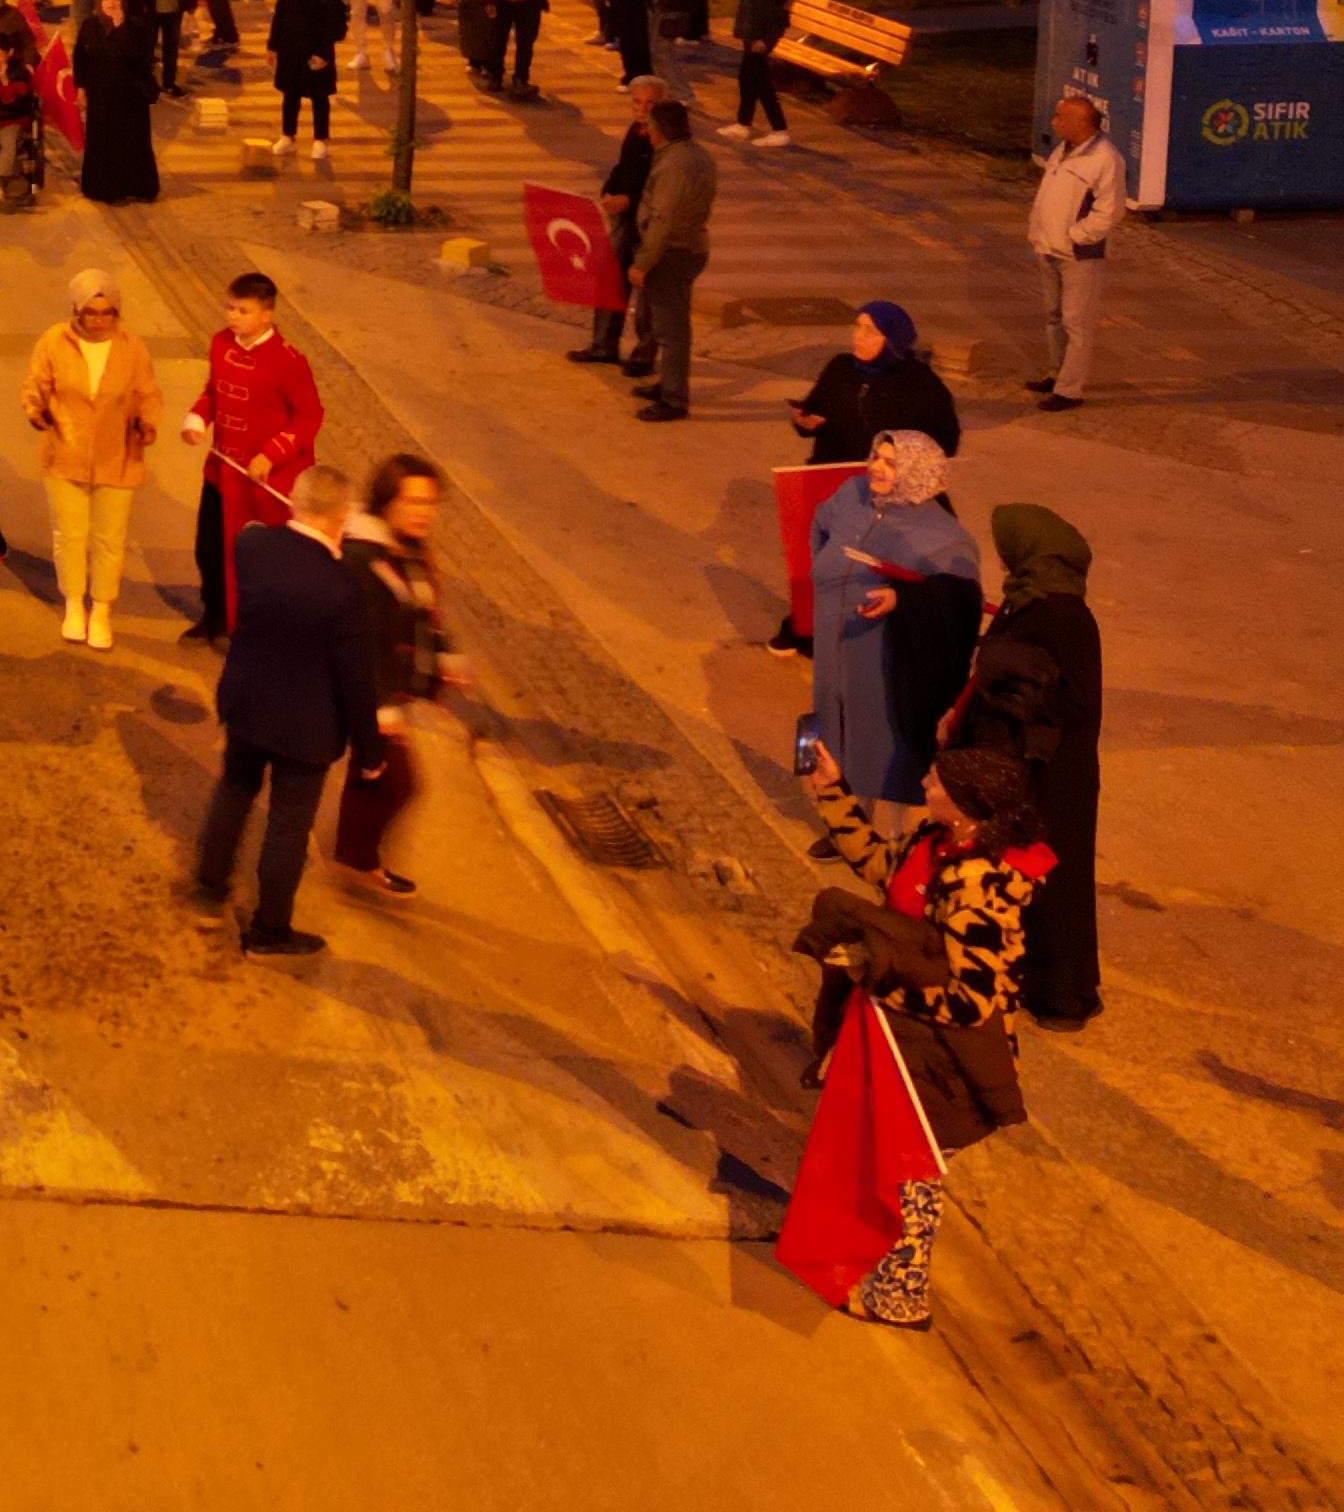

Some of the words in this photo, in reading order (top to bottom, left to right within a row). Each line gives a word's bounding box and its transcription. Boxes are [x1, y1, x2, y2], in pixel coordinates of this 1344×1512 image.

[1258, 26, 1310, 37] KARTON
[1253, 101, 1311, 121] SIFIR
[1253, 120, 1309, 141] ATIK
